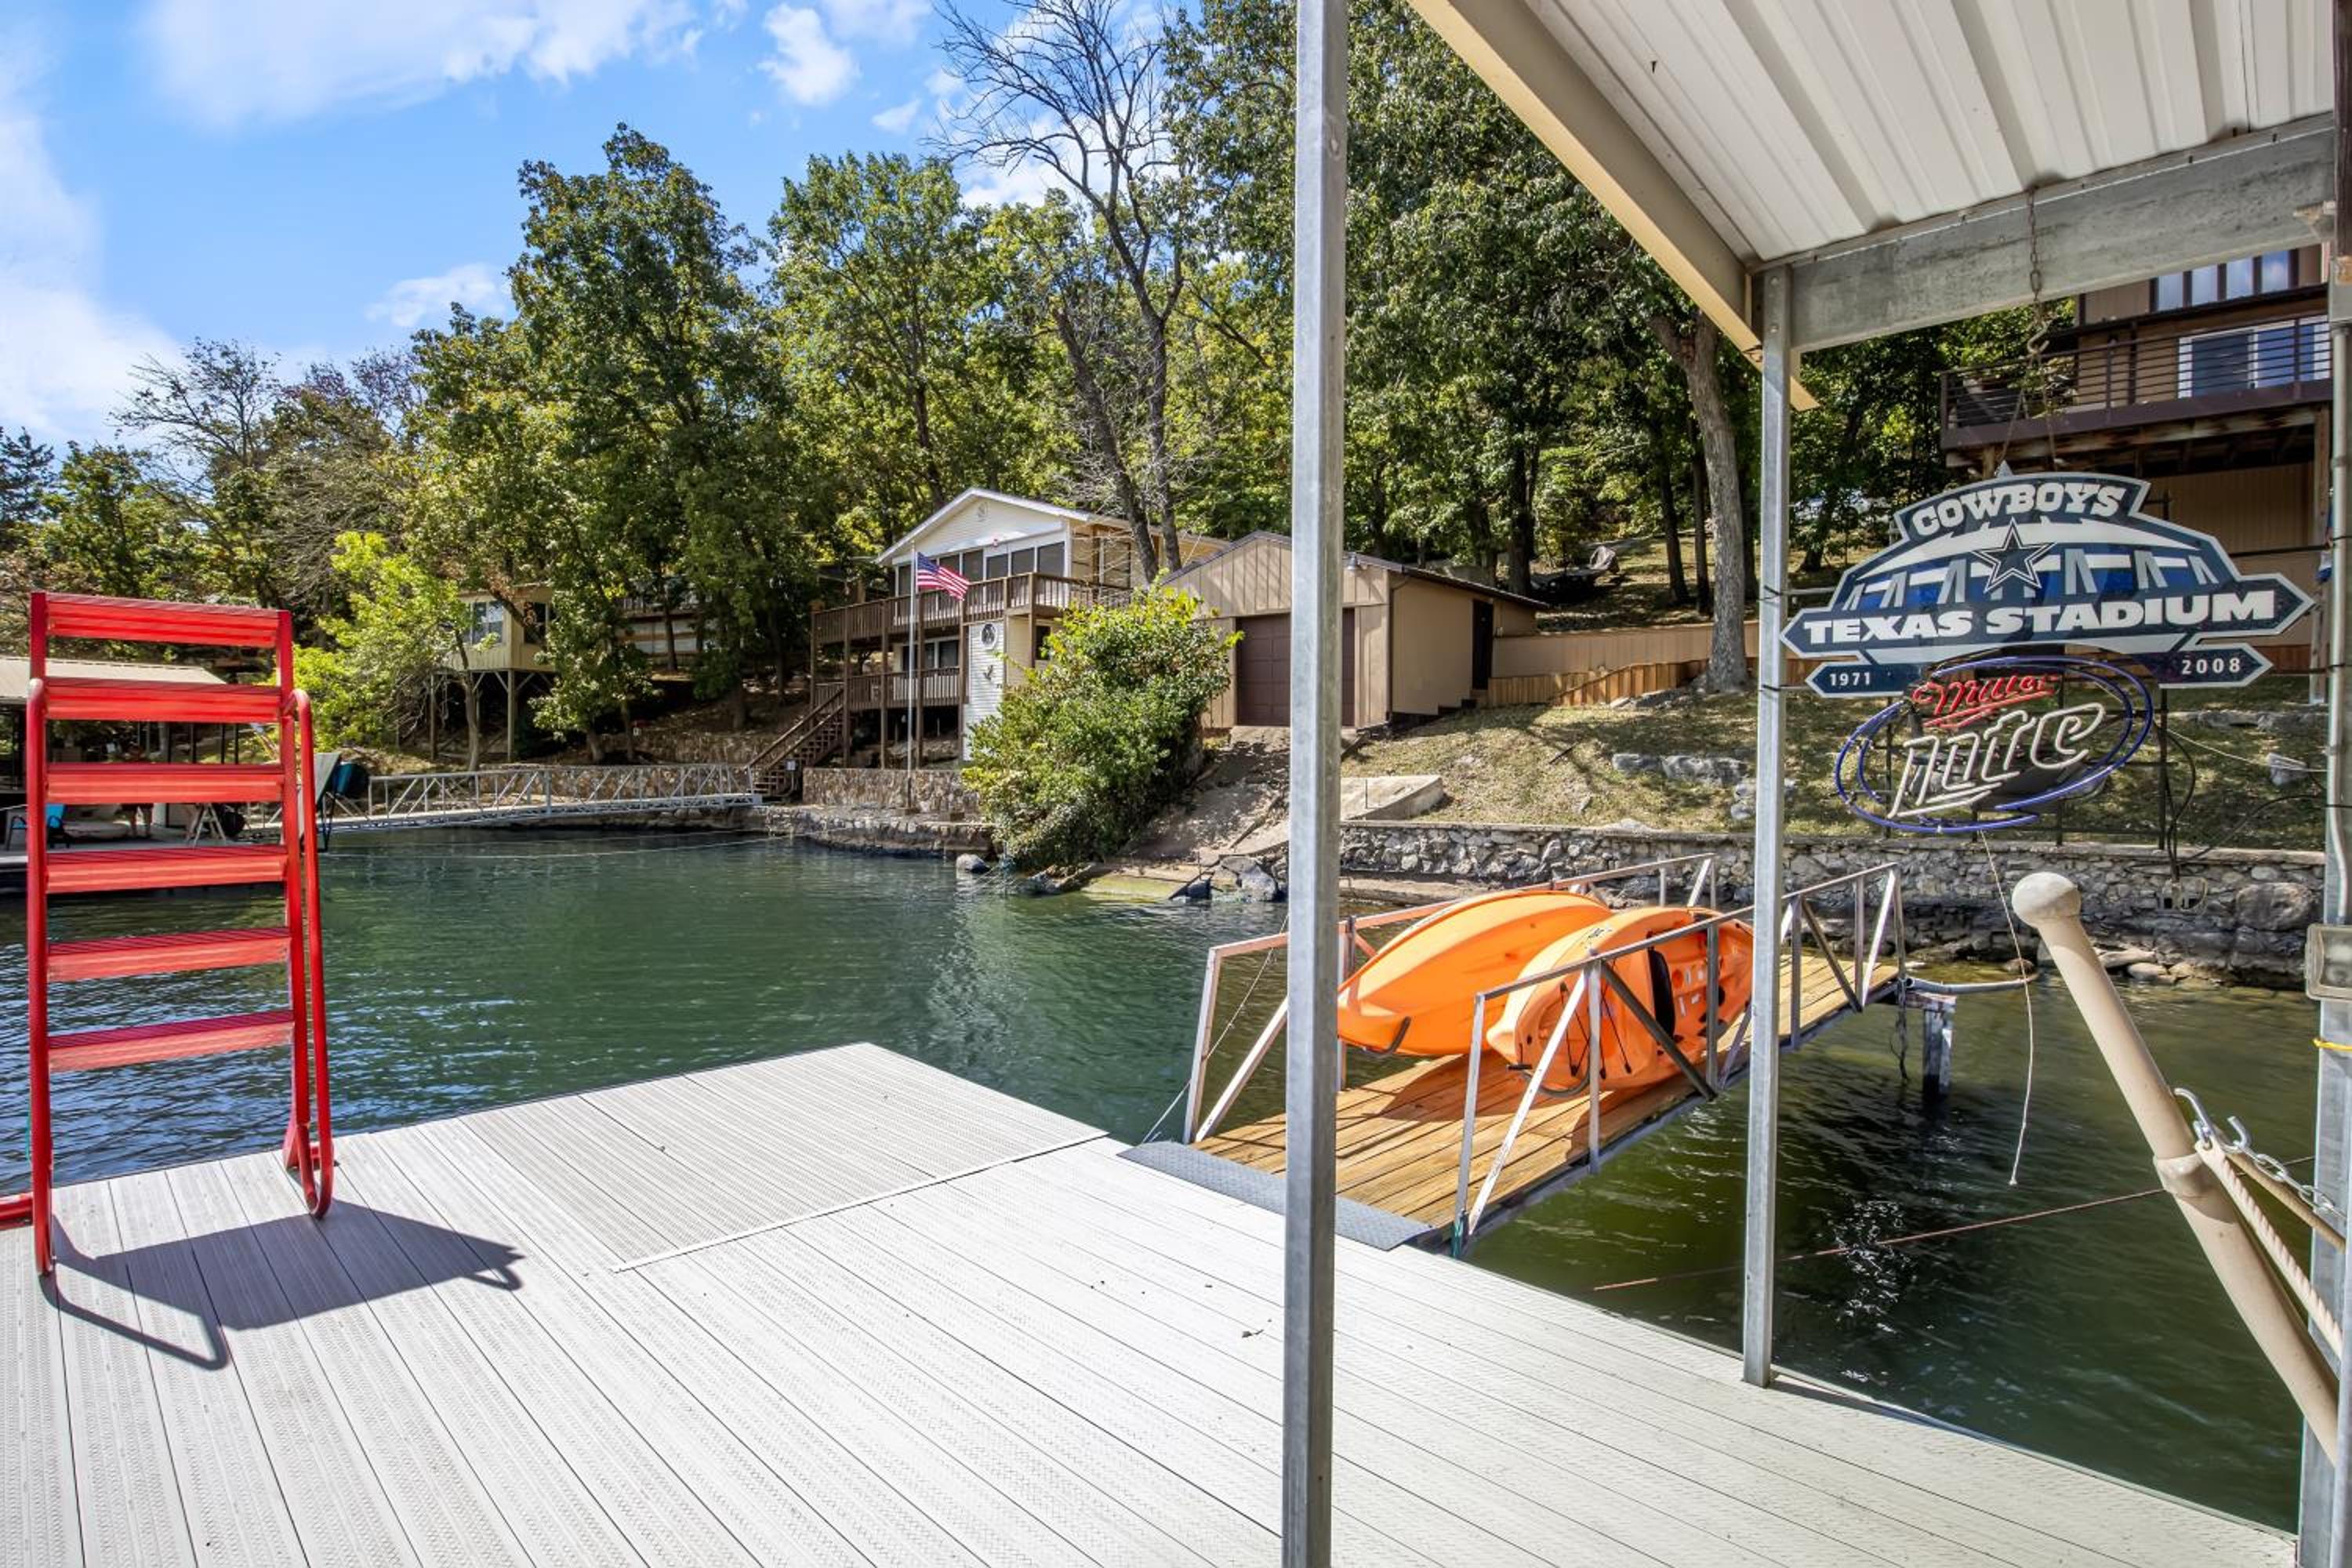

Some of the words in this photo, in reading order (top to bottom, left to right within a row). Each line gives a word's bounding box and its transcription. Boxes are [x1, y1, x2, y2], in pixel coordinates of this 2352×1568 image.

[1911, 481, 2127, 536] COWBOYS
[1803, 610, 1973, 645] TEXAS
[1985, 590, 2274, 634] STADIUM
[1829, 671, 1871, 687] 1971
[2181, 657, 2241, 675] 2008
[1910, 675, 2059, 720] Miller
[1887, 702, 2106, 818] Lite
